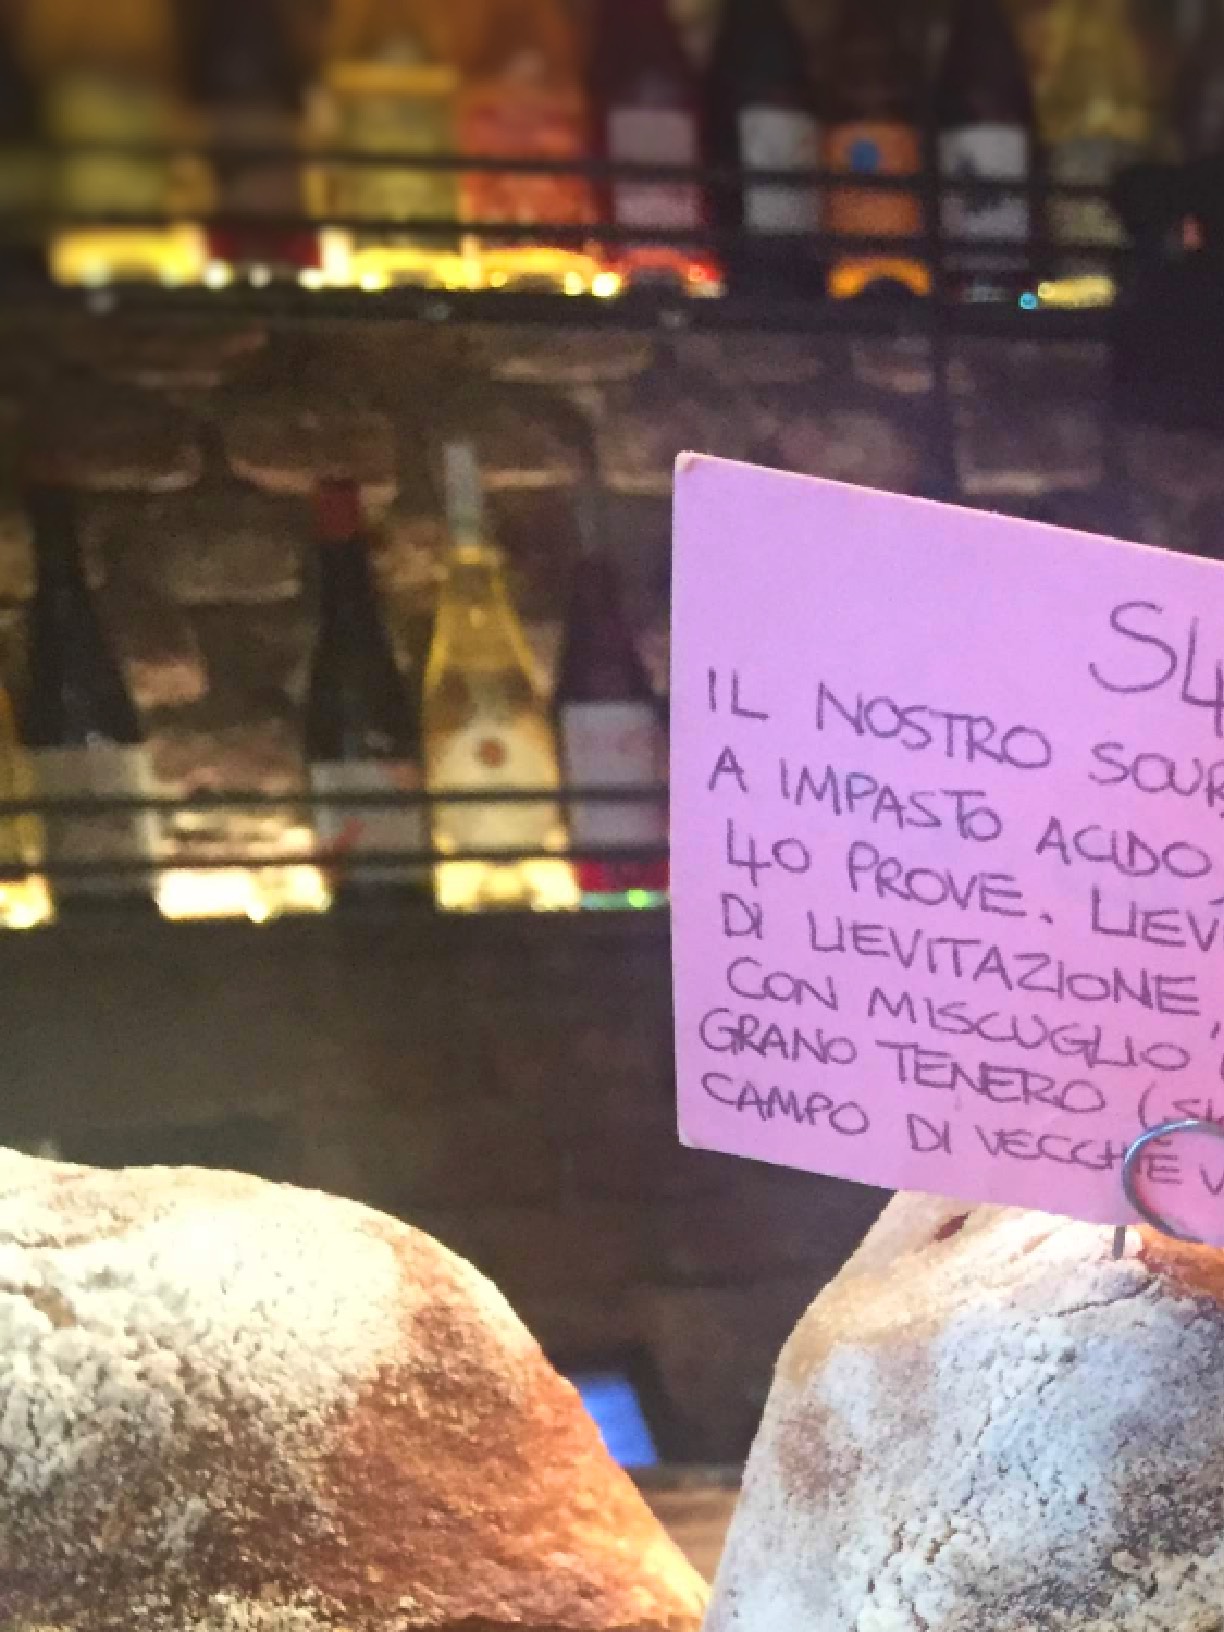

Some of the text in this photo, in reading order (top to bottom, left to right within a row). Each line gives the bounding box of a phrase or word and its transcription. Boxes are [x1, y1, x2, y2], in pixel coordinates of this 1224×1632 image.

[706, 666, 769, 721] IL
[815, 680, 1053, 770] NOSTRO
[707, 745, 748, 794] A
[780, 757, 1003, 844] IMPASTO
[726, 818, 811, 888] 40
[846, 840, 1054, 925] PROVE.
[720, 893, 764, 939] DI
[806, 910, 1222, 1040] LIEVITAZIONE,
[726, 956, 839, 1011] CON
[867, 986, 1192, 1071] MISCUGLIO
[699, 1006, 858, 1065] GRANO
[875, 1039, 1107, 1114] TENERO
[701, 1071, 870, 1137] CAMPO
[906, 1113, 953, 1155] DI
